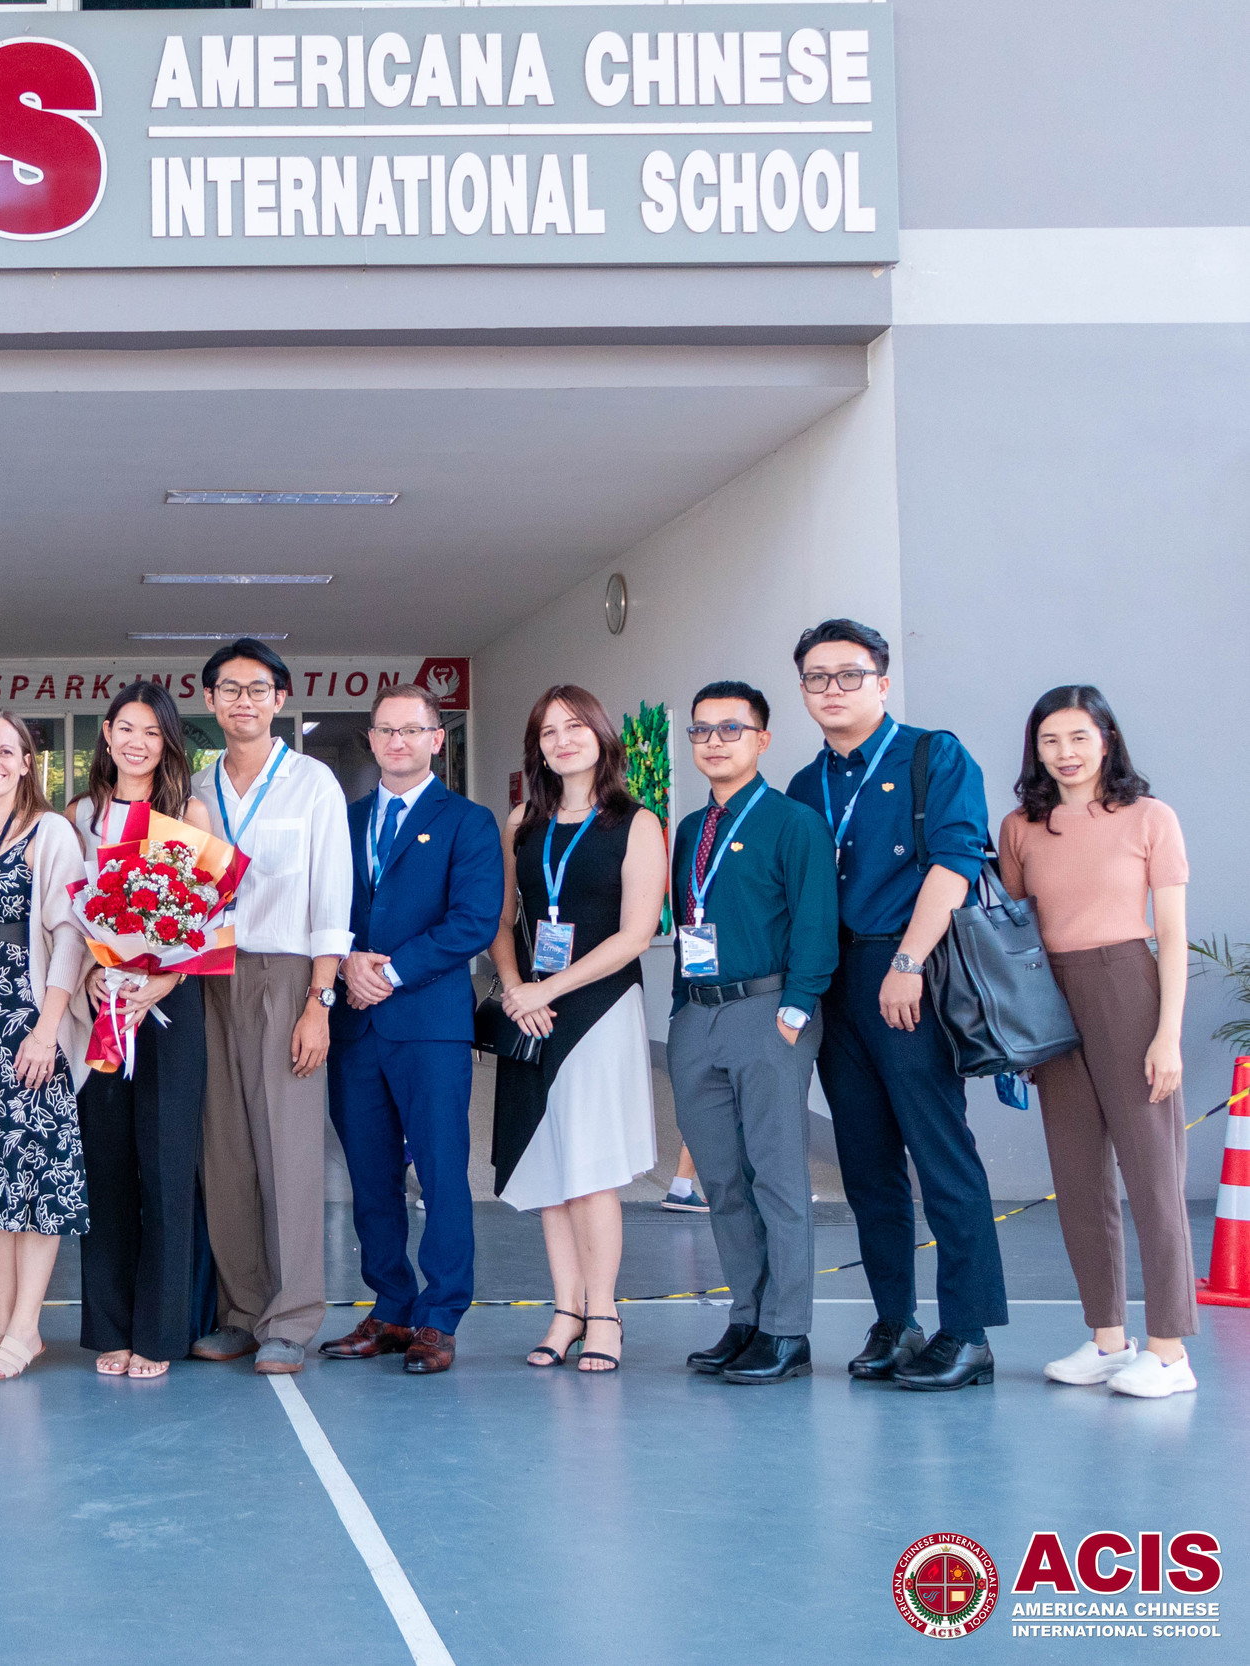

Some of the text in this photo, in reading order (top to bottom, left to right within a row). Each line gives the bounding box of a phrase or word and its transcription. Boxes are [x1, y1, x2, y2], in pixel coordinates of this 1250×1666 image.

[151, 28, 872, 109] AMERICANA CHINESE
[151, 149, 877, 238] INTERNATIONAL SCHOOL
